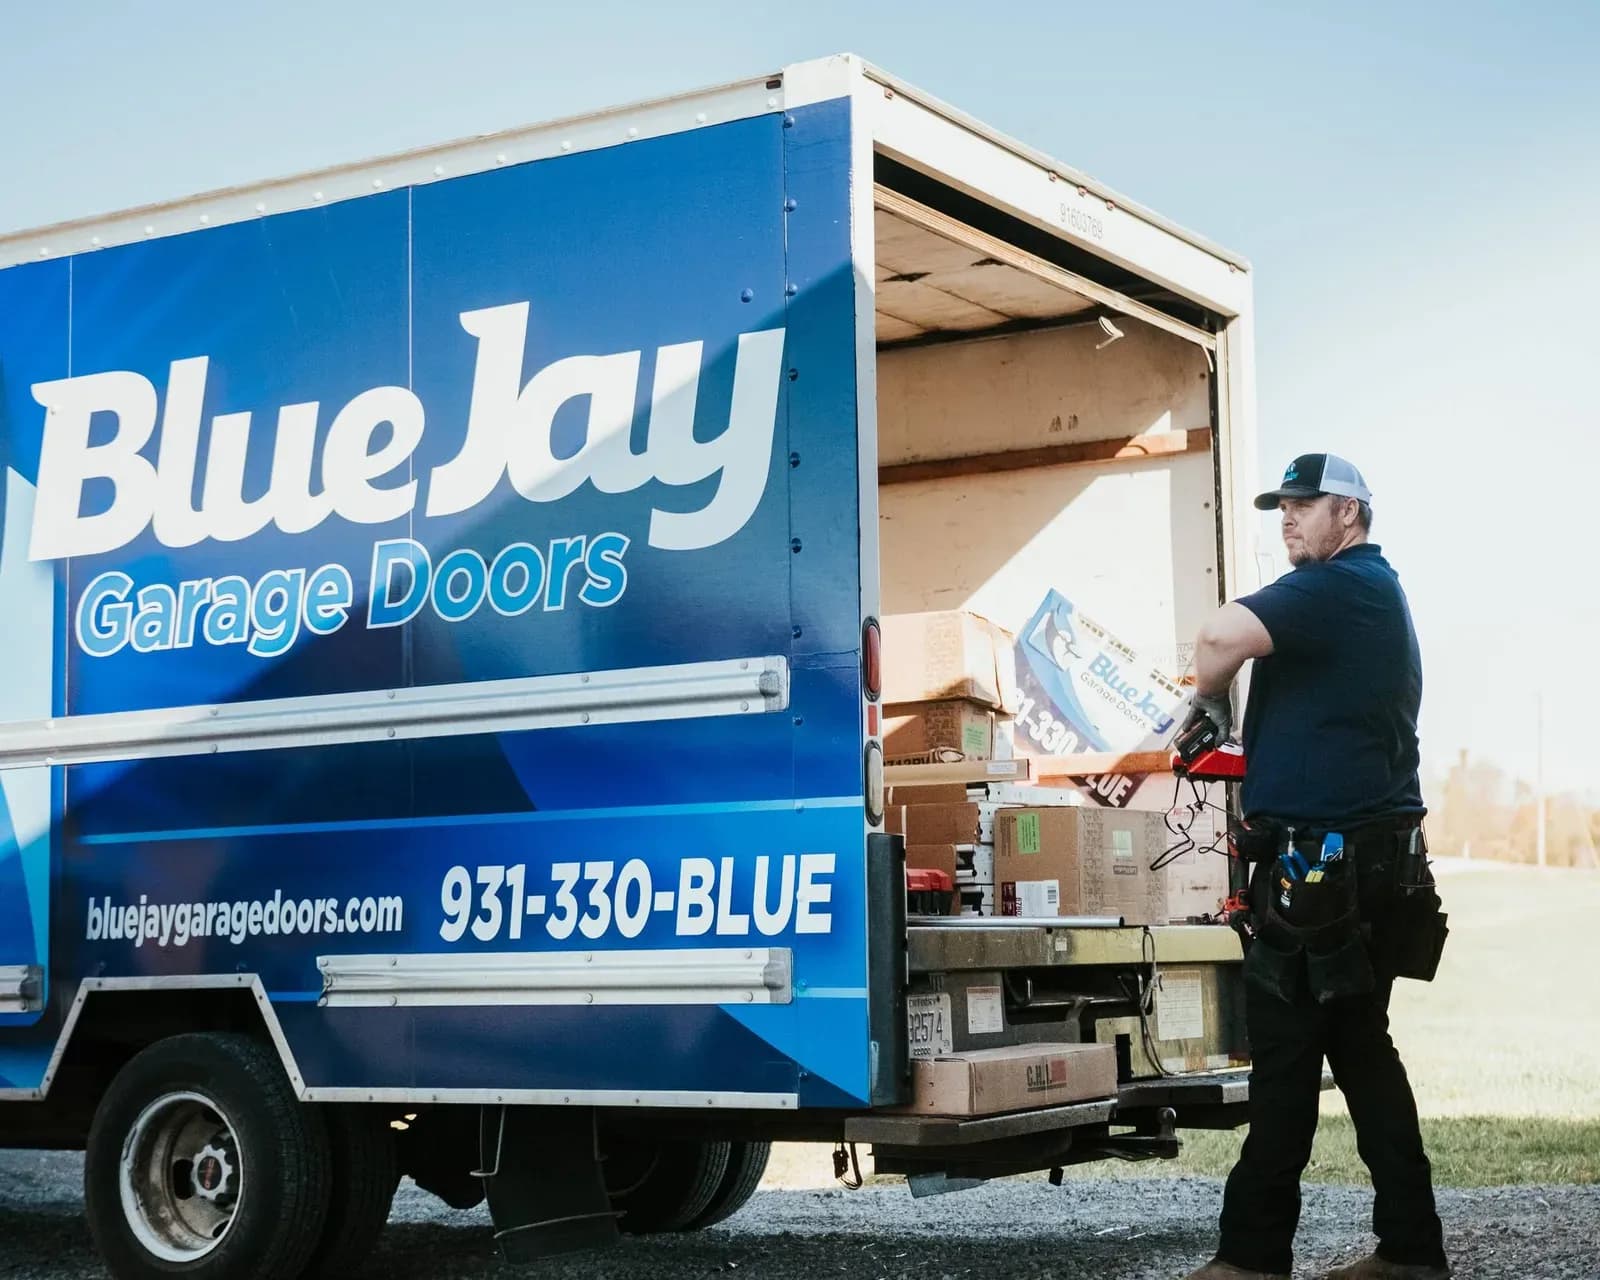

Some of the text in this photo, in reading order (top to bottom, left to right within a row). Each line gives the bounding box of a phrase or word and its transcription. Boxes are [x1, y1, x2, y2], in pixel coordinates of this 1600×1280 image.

[76, 532, 630, 656] Garage Doors
[1080, 672, 1146, 729] Garage Doors
[86, 890, 403, 947] bluejaygaragedoors.com
[440, 853, 836, 942] 931-330-BLUE
